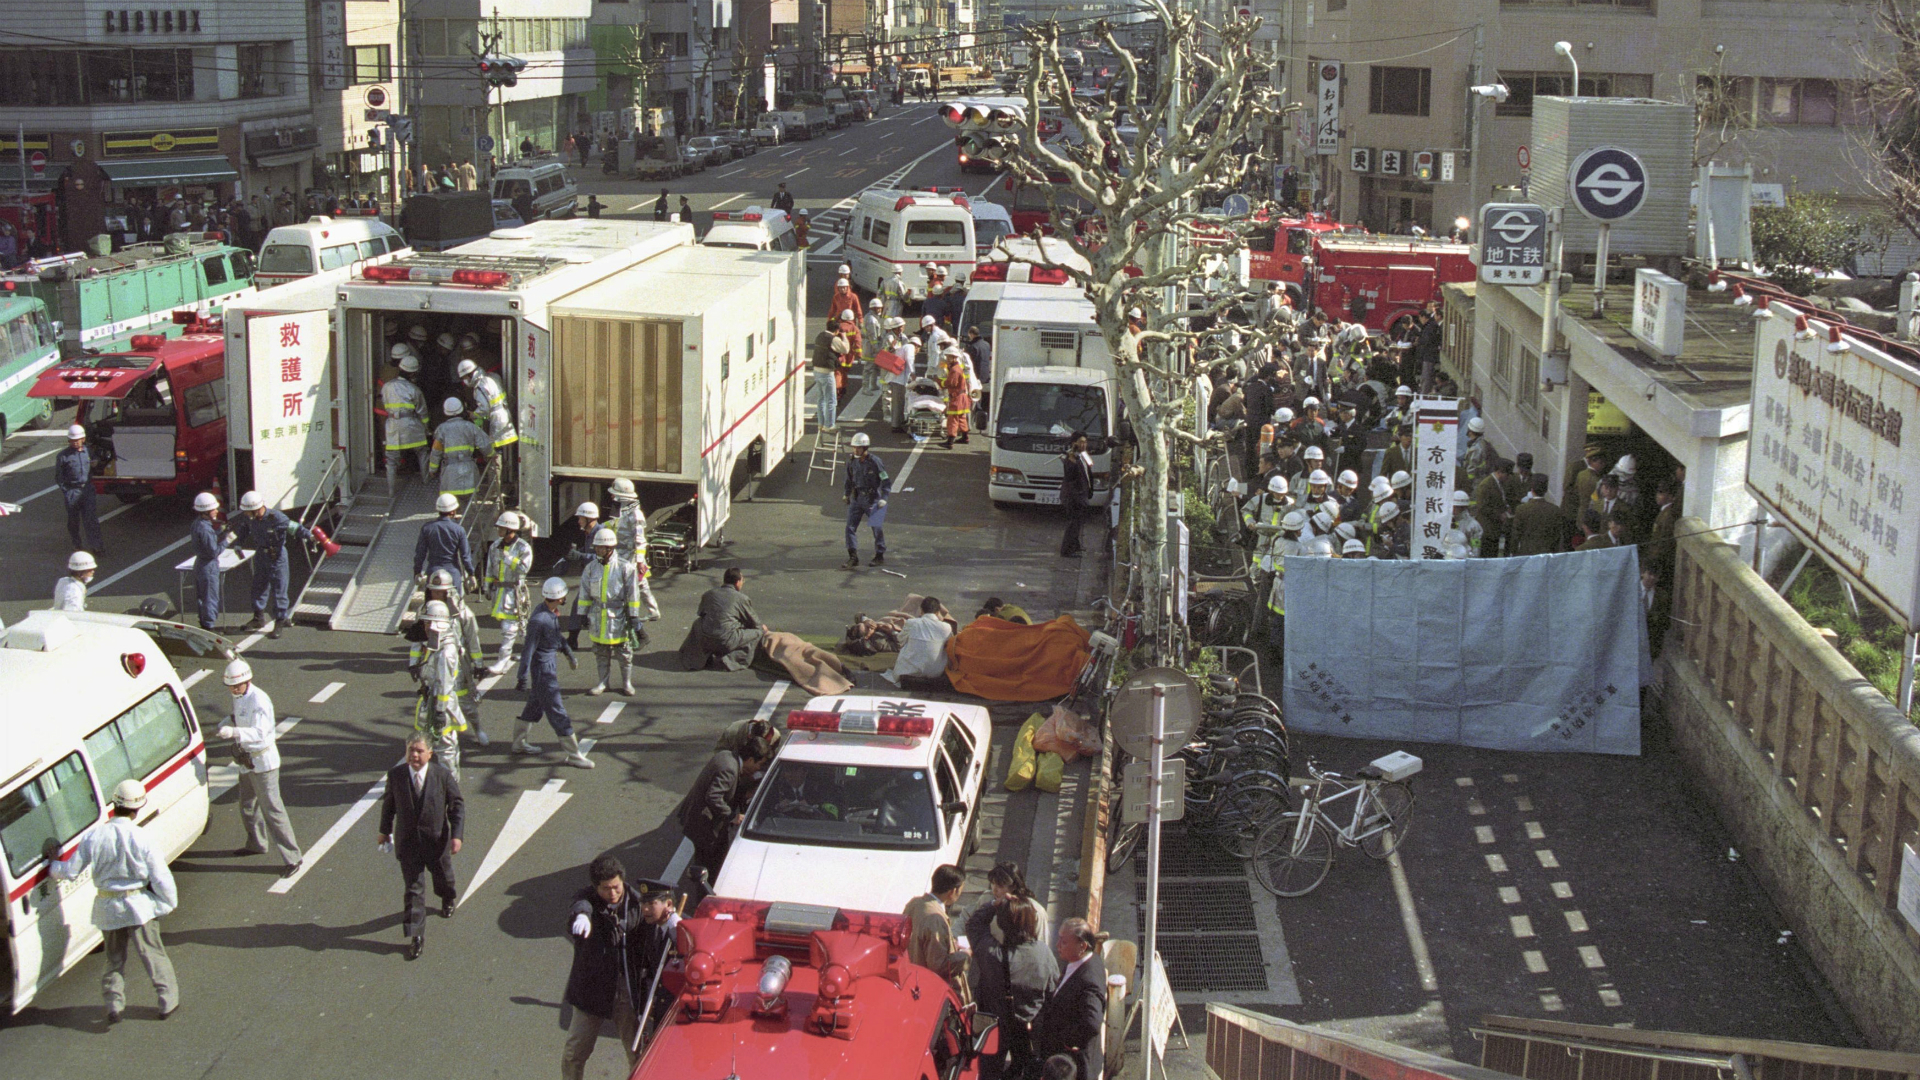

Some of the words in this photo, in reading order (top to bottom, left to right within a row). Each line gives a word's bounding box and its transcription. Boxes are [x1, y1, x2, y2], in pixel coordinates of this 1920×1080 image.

[1319, 88, 1338, 136] おそば
[1486, 247, 1540, 264] 地下鉄
[1493, 270, 1531, 279] 築地駅
[280, 322, 303, 418] 救護所
[260, 421, 325, 440] 東京消防庁
[1803, 464, 1844, 511] コンサート
[1850, 498, 1899, 557] 日本料理
[1877, 472, 1903, 514] 宿泊
[1298, 670, 1354, 724] 東京消防庁
